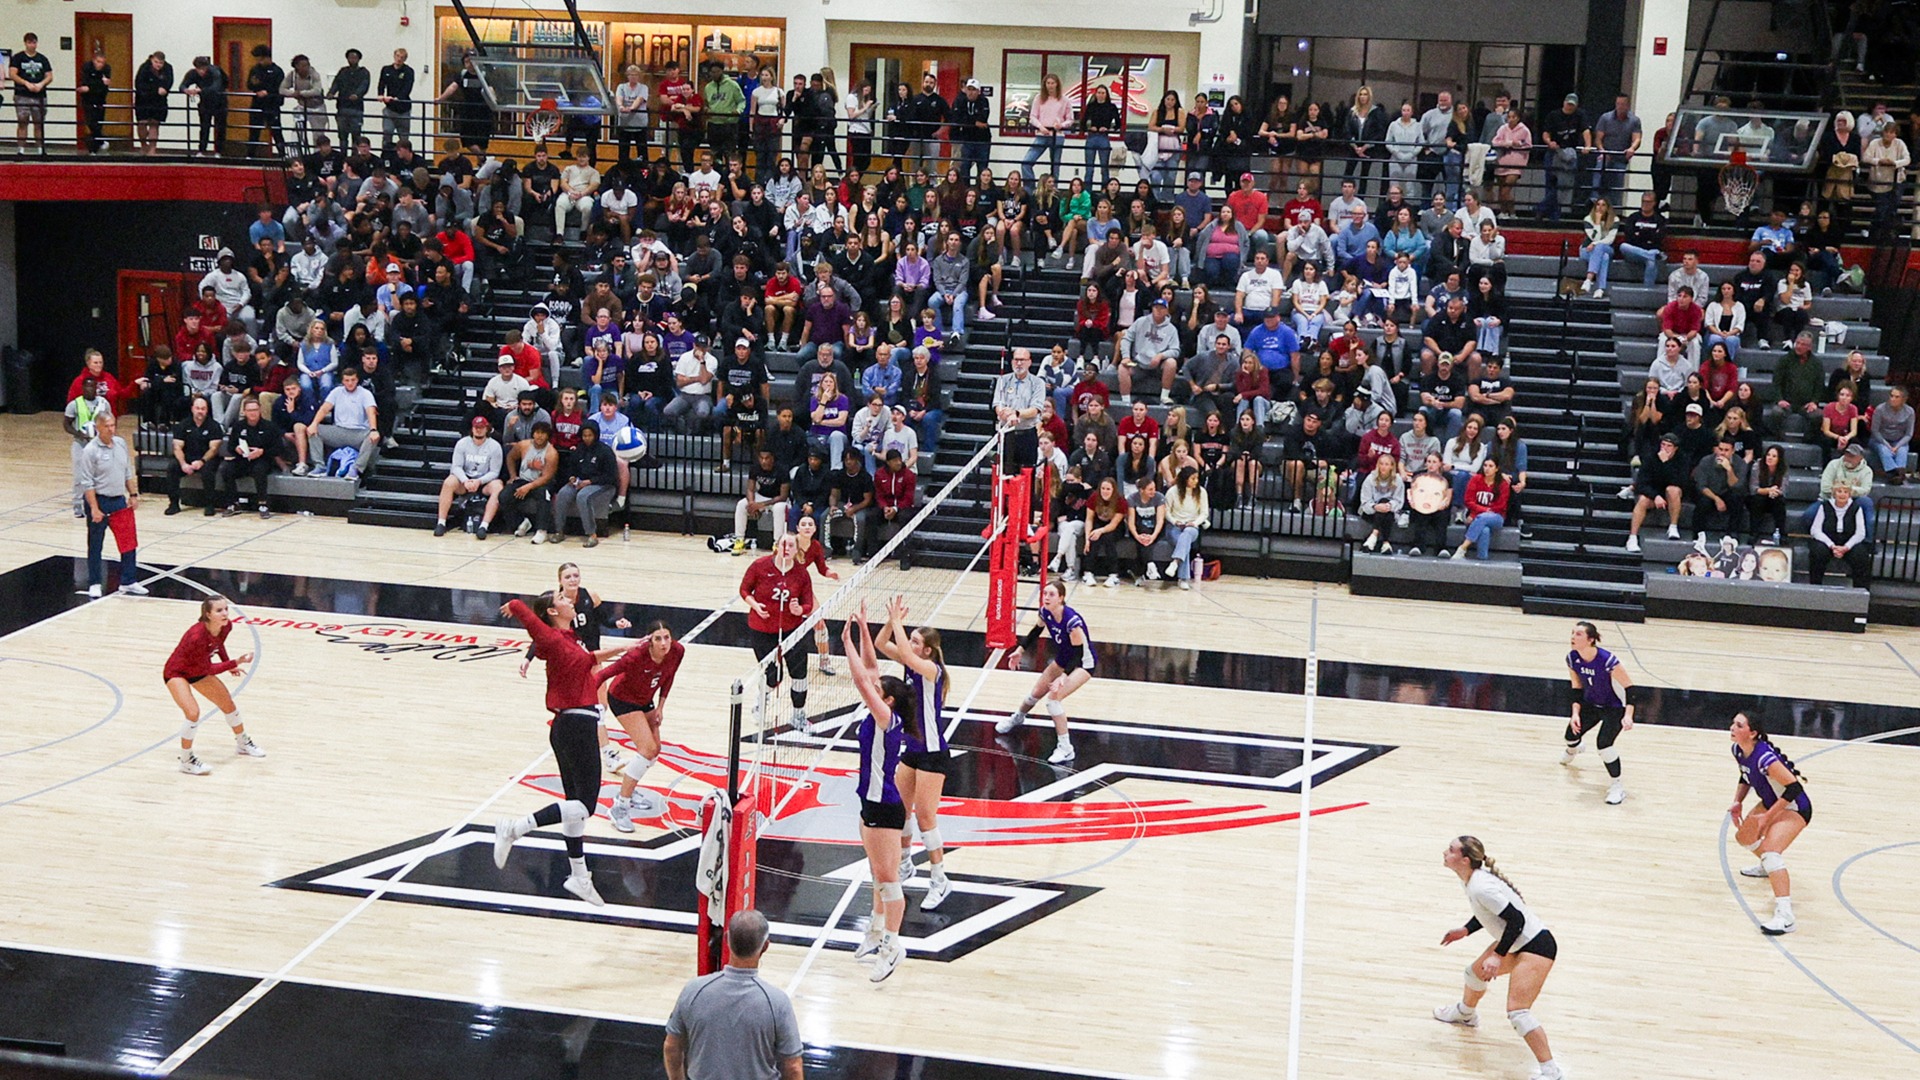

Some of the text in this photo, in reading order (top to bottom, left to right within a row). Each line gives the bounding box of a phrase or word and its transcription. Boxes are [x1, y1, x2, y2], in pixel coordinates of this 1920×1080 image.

[771, 587, 790, 602] 22
[573, 612, 587, 628] 19
[231, 616, 533, 649] UE WILLEY COURT
[1580, 666, 1596, 676] SBU
[650, 677, 660, 688] 5
